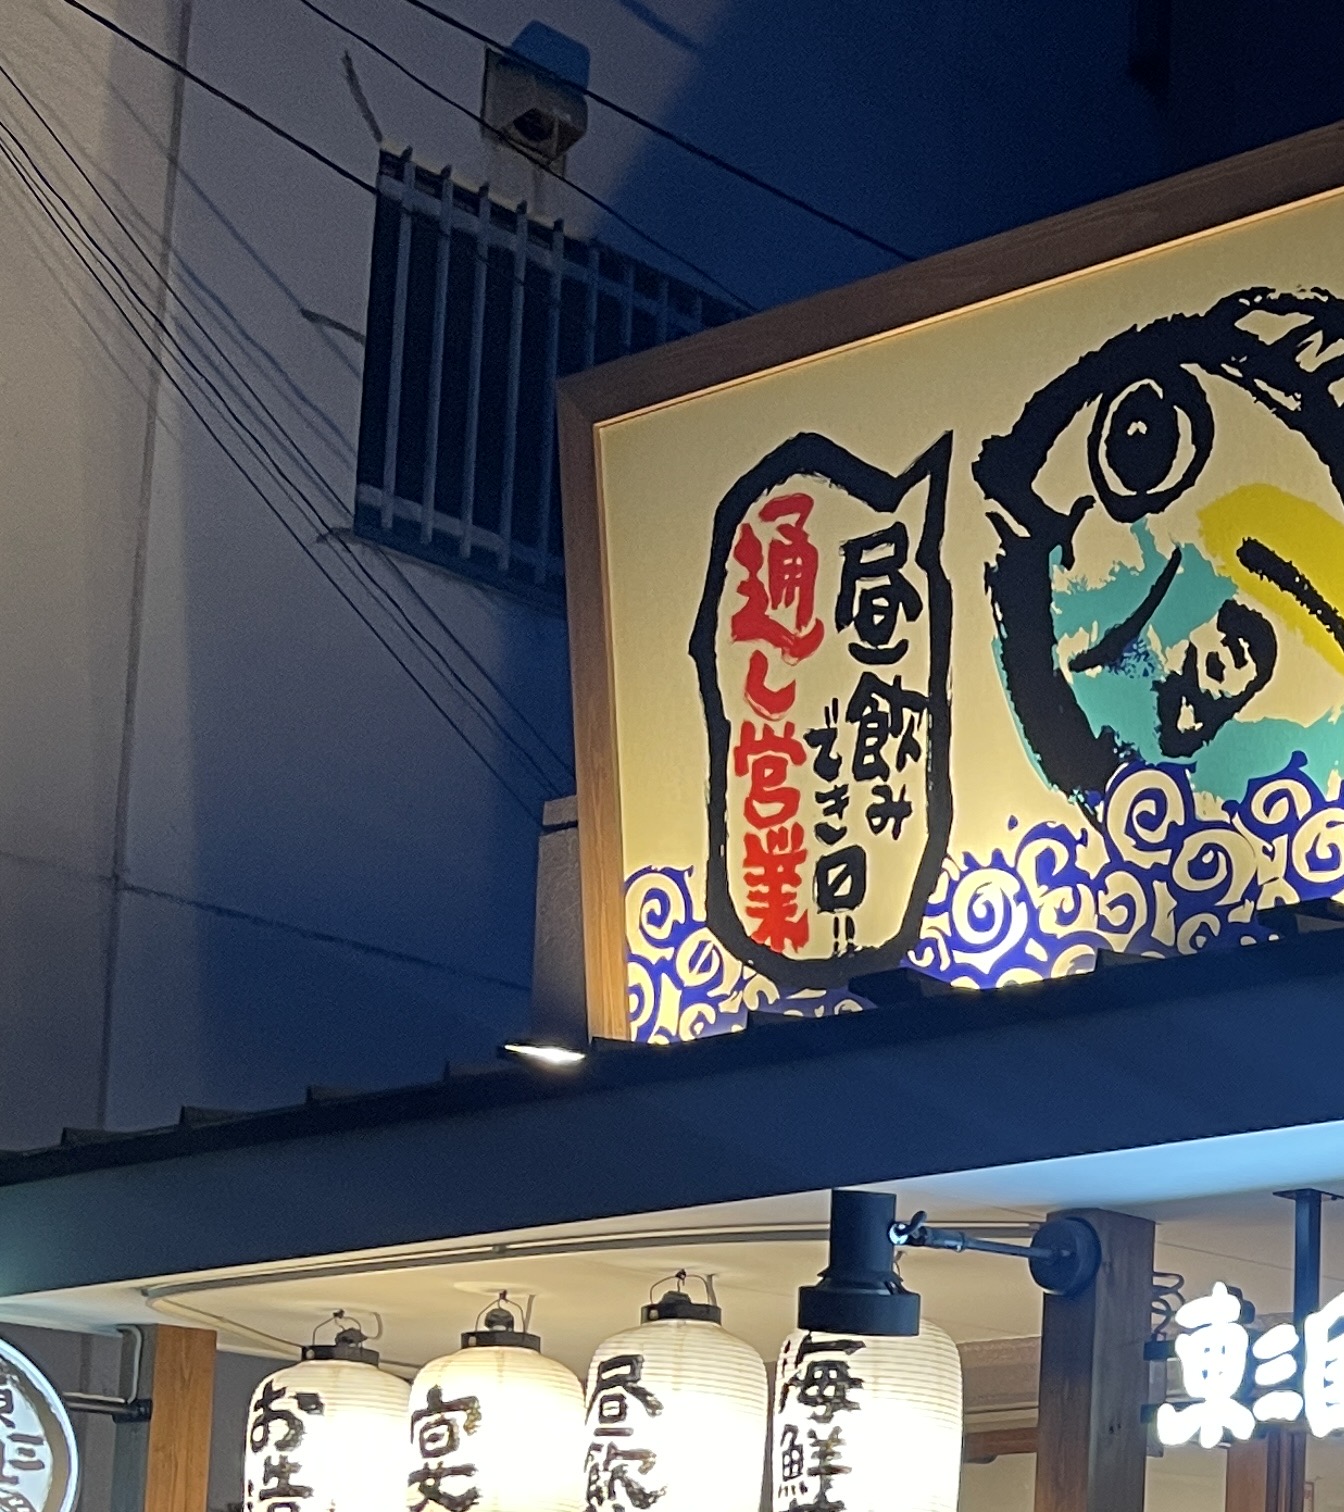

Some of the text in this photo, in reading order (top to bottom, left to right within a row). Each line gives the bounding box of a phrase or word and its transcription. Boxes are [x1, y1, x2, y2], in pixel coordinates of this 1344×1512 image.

[731, 491, 825, 954] 通し営業
[835, 520, 930, 841] 昼飲み
